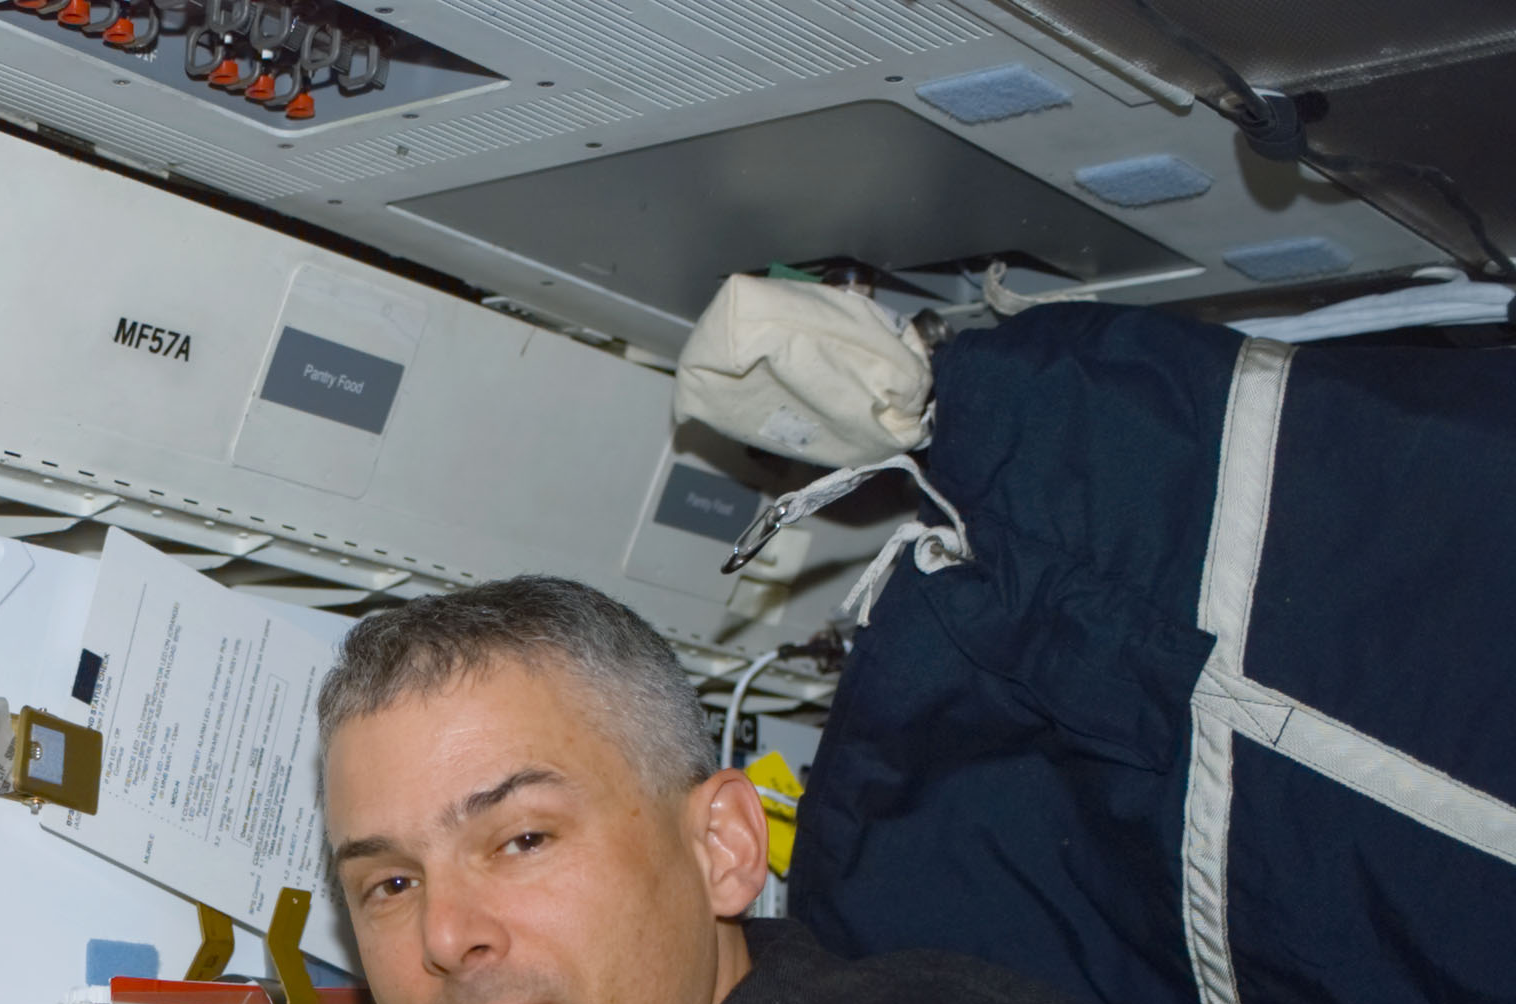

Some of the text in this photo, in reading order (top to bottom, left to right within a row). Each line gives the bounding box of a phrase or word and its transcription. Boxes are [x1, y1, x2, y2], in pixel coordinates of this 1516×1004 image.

[113, 317, 192, 362] MF57A
[303, 364, 364, 395] Pantry Food
